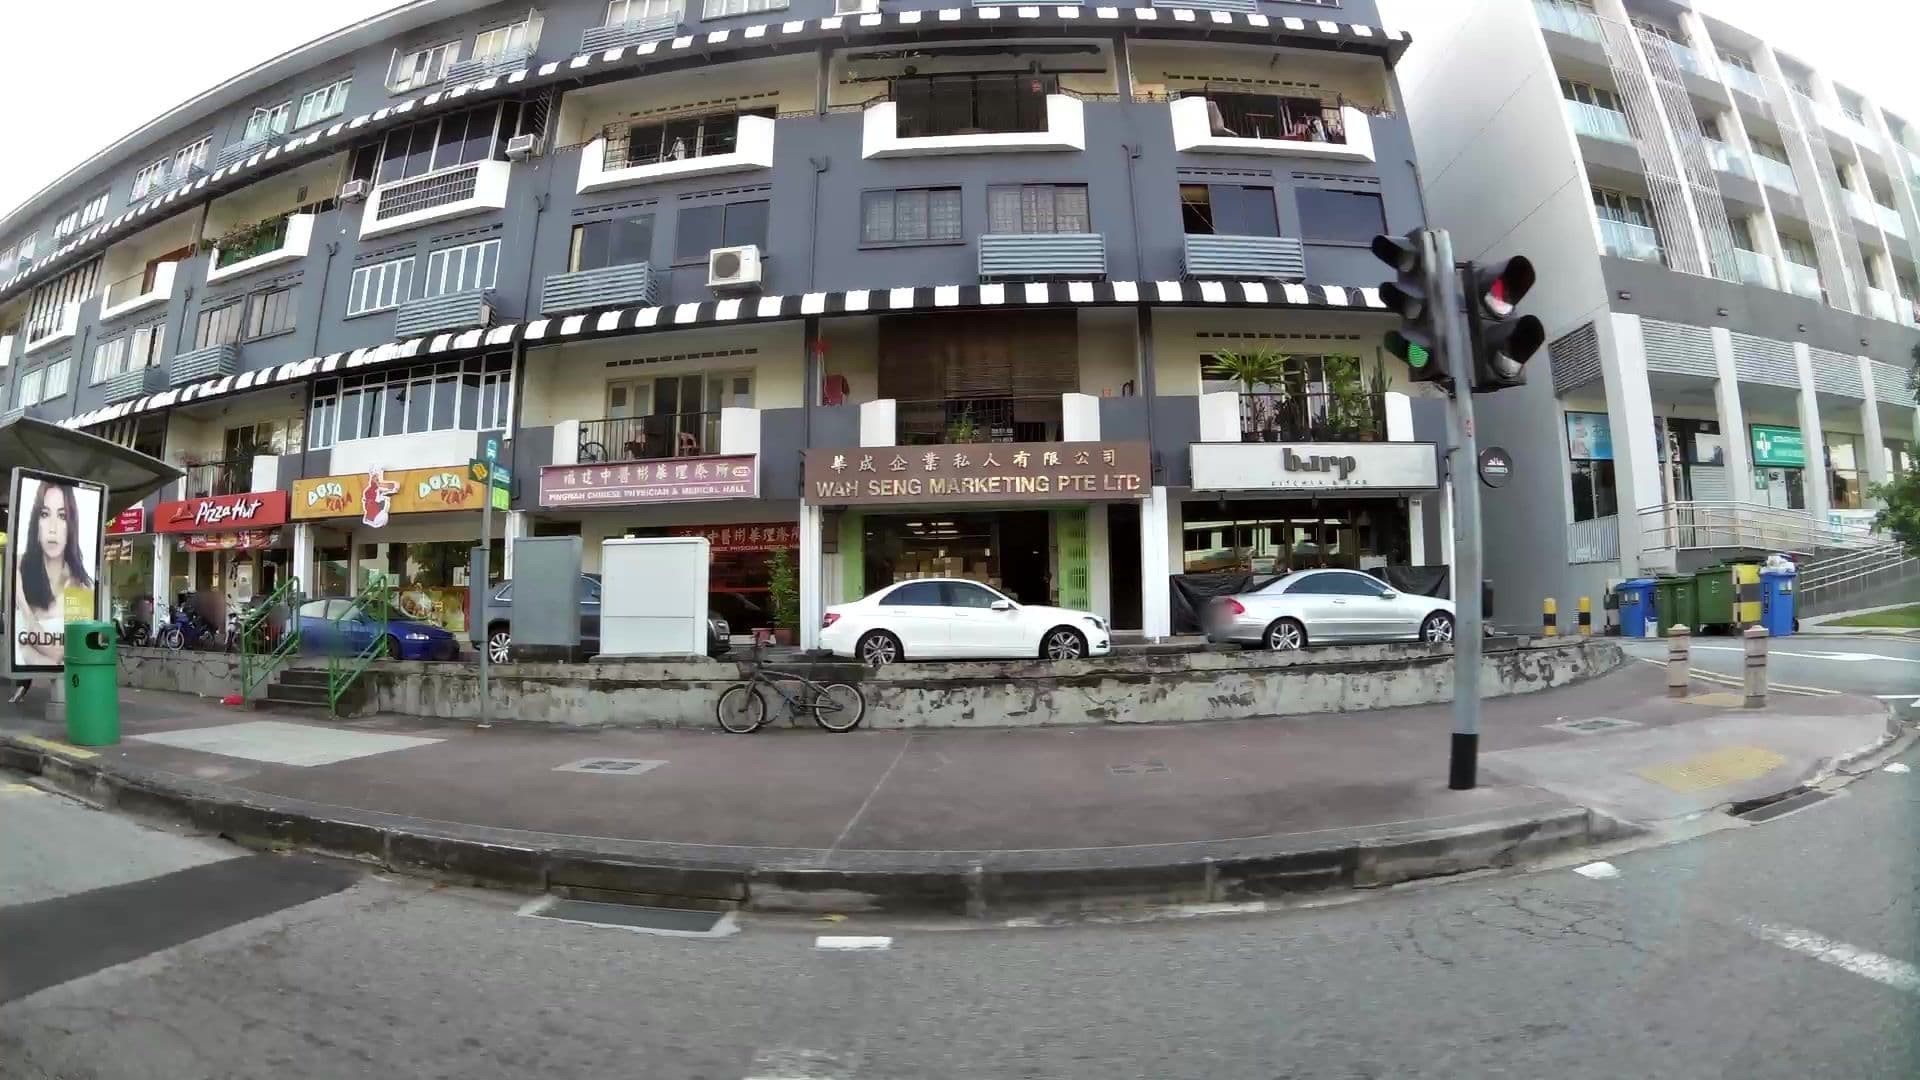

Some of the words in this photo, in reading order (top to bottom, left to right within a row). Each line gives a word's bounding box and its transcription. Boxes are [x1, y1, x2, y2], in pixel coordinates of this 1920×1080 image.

[829, 449, 1117, 474] 華成企業私人有限公司
[1282, 447, 1357, 481] burp
[307, 482, 343, 507] DOSA
[418, 472, 461, 499] DOSA
[587, 489, 621, 500] CHINESE
[623, 488, 669, 498] PHYSICIAN
[682, 486, 720, 496] MEDICAL
[722, 483, 746, 494] HALL
[816, 480, 859, 498] WAH
[868, 478, 922, 496] SENG
[929, 476, 1050, 495] MARKETING
[1057, 474, 1097, 492] PTE
[1103, 474, 1142, 492] LTD
[195, 500, 232, 525] Pizza
[231, 497, 263, 520] Hut
